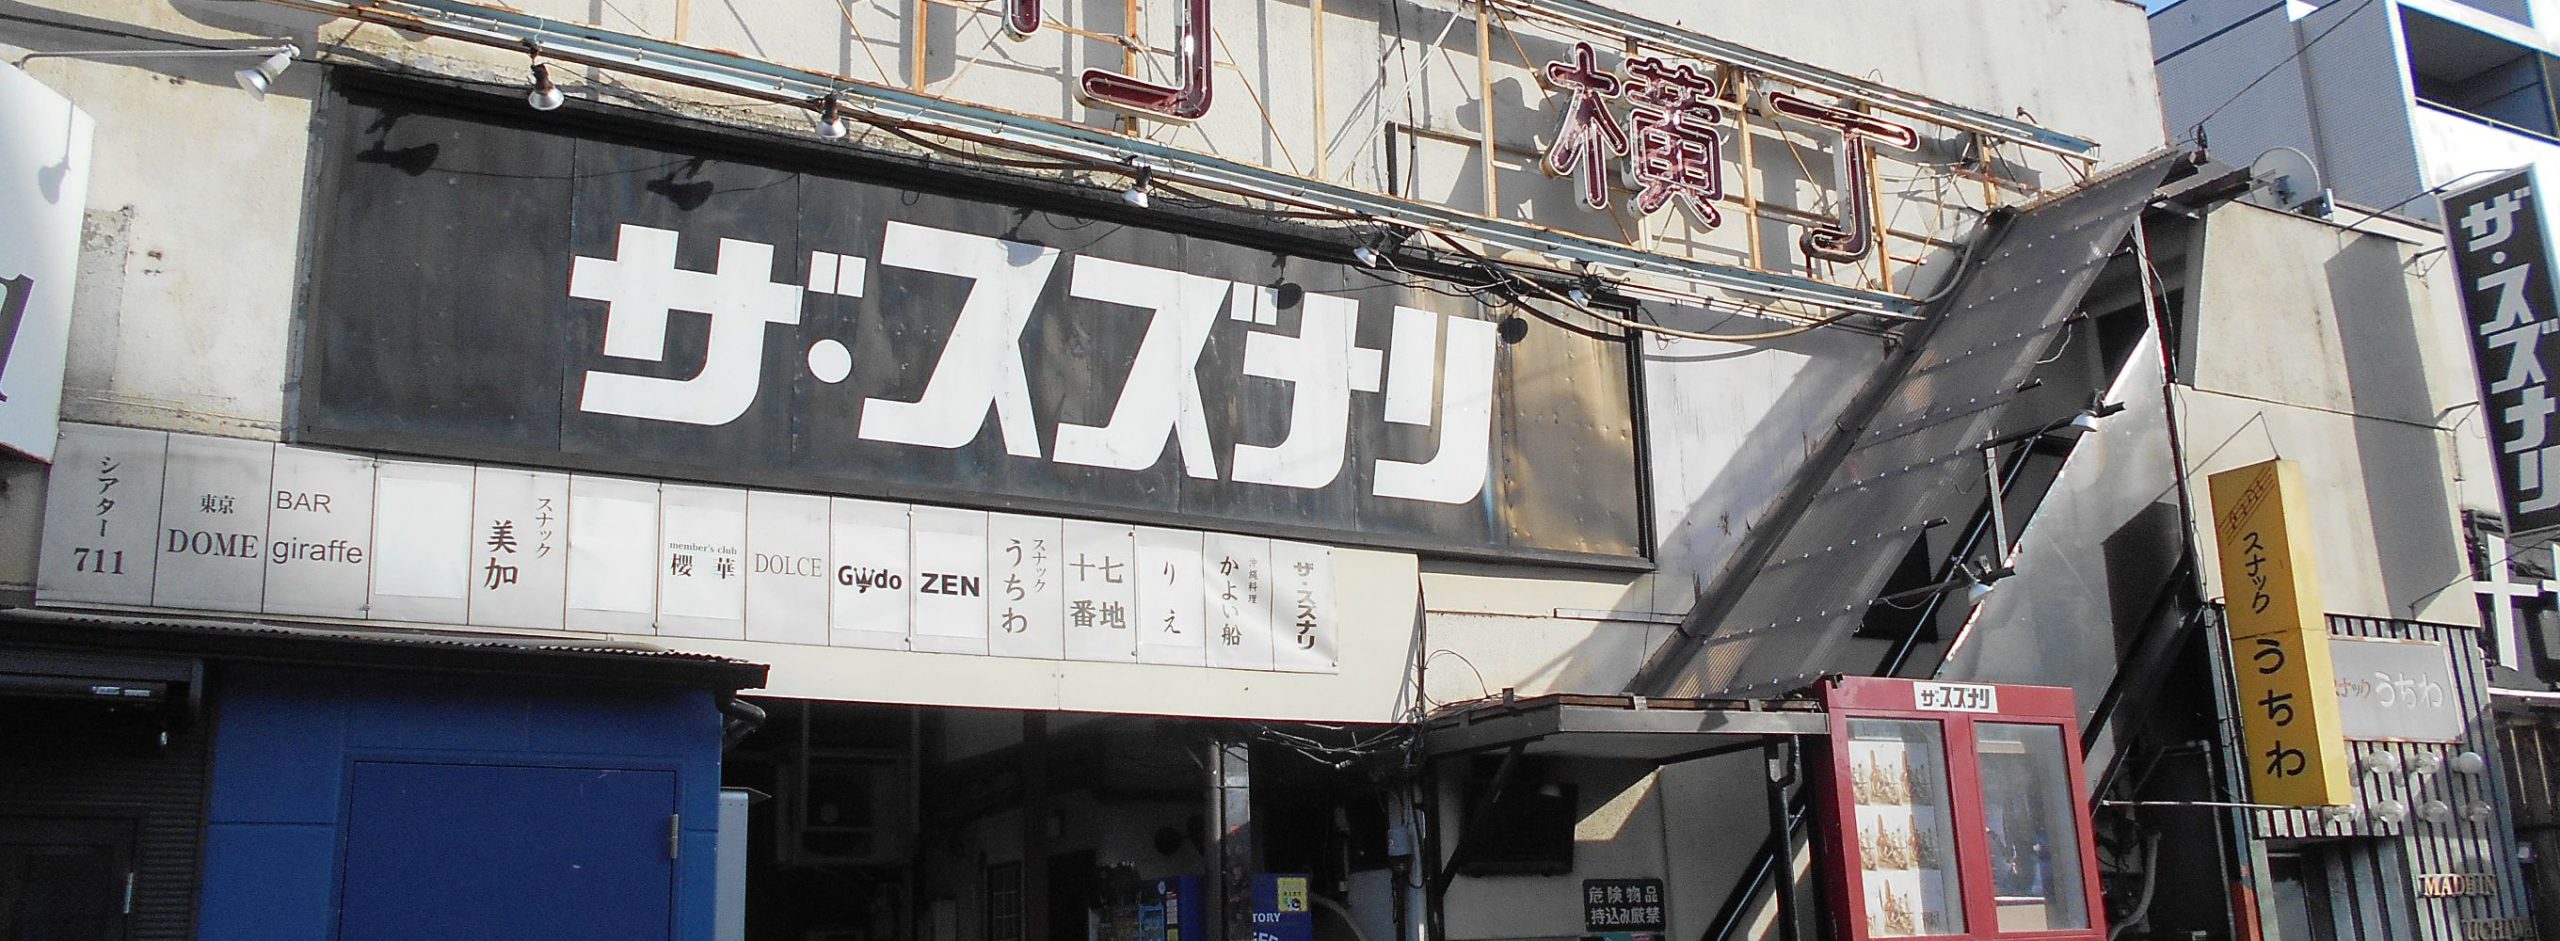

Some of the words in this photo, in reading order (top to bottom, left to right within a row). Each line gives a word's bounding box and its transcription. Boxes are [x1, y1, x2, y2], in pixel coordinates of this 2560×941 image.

[1546, 40, 1921, 264] 横丁
[569, 221, 1498, 505] ザ・スズナリ
[2461, 187, 2560, 514] ザ・スズナリ
[97, 455, 120, 538] シアター
[199, 493, 236, 515] 東京
[276, 490, 332, 514] BAR
[166, 528, 259, 559] DOME
[272, 536, 364, 564] giraffe
[483, 519, 519, 591] 美加
[535, 497, 555, 559] スナック
[669, 541, 715, 554] member's
[717, 544, 738, 555] club
[73, 546, 125, 576] 711
[754, 553, 822, 578] DOLCE
[920, 571, 981, 598] ZEN
[1001, 538, 1028, 634] うちわ
[1031, 538, 1048, 593] スナック
[2242, 531, 2271, 614] スナック
[1163, 560, 1182, 635] りえ
[1219, 555, 1243, 647] かよい船
[2253, 637, 2307, 779] うちわ
[2375, 670, 2443, 709] うちわ
[1588, 885, 1659, 904] 危険物品
[1590, 906, 1661, 926] 持込み厳禁
